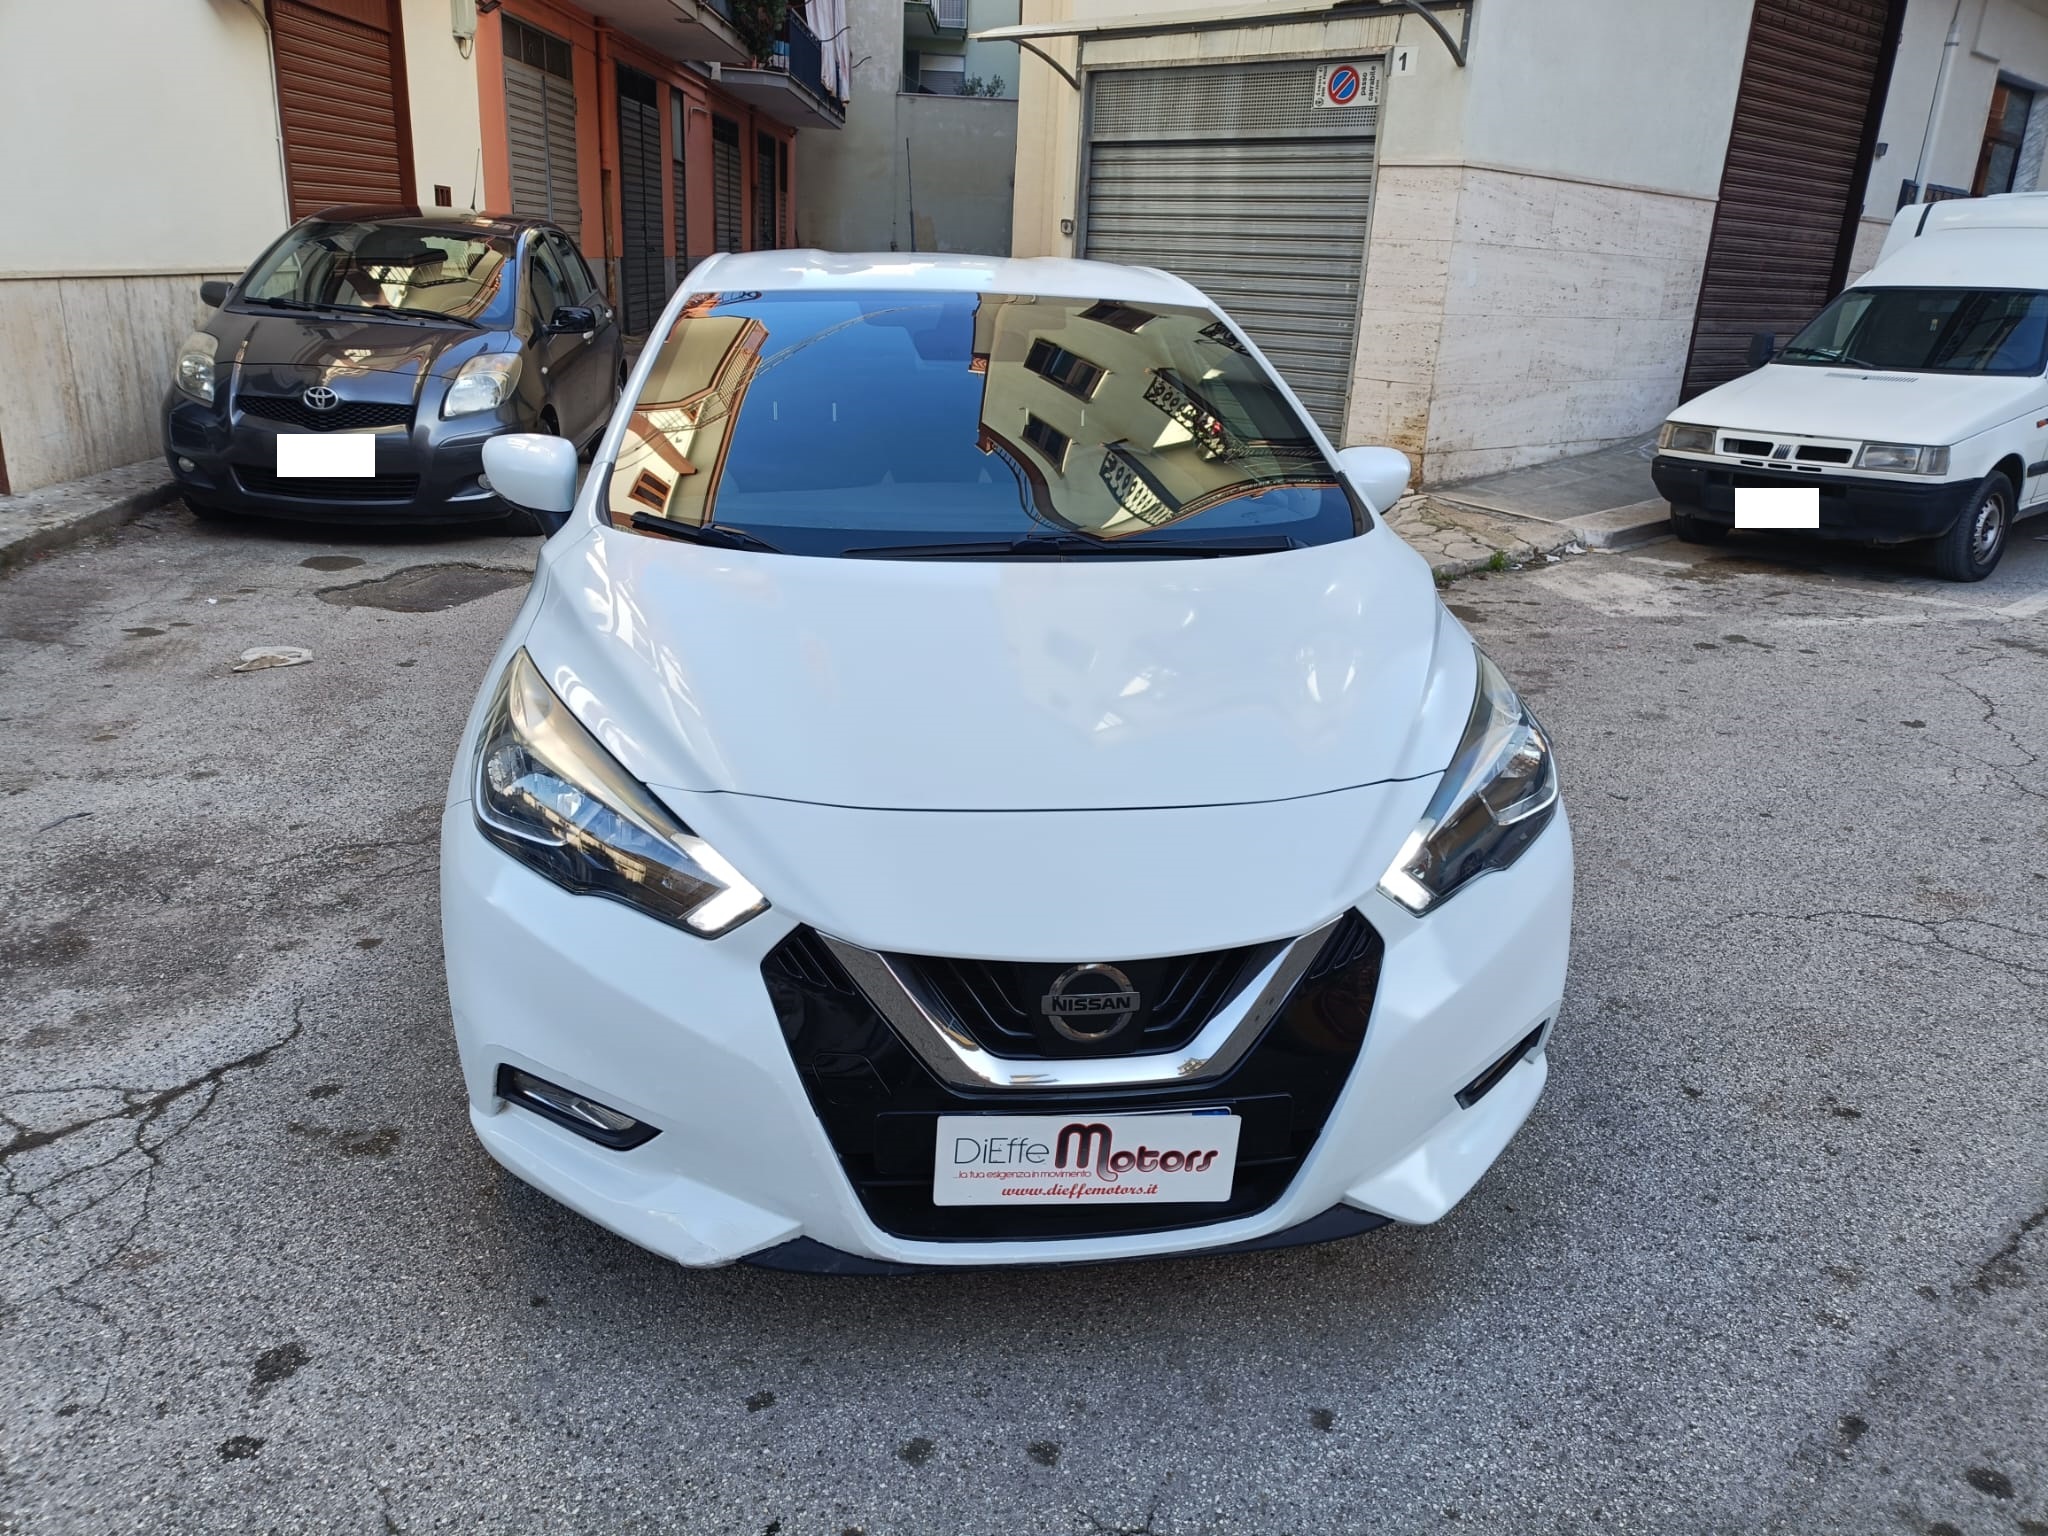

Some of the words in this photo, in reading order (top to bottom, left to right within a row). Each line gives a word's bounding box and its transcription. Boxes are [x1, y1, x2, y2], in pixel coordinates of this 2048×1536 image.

[1399, 52, 1407, 71] 1
[1368, 65, 1376, 101] carrabile
[1052, 995, 1130, 1012] NISSAN
[954, 1136, 1050, 1165] DiEffe
[1054, 1122, 1219, 1183] Motors
[969, 1170, 985, 1179] tua
[986, 1170, 1031, 1181] esigenza
[1031, 1169, 1040, 1178] in
[1040, 1169, 1092, 1178] movimento
[1001, 1183, 1158, 1199] www.dieffemotors.it
